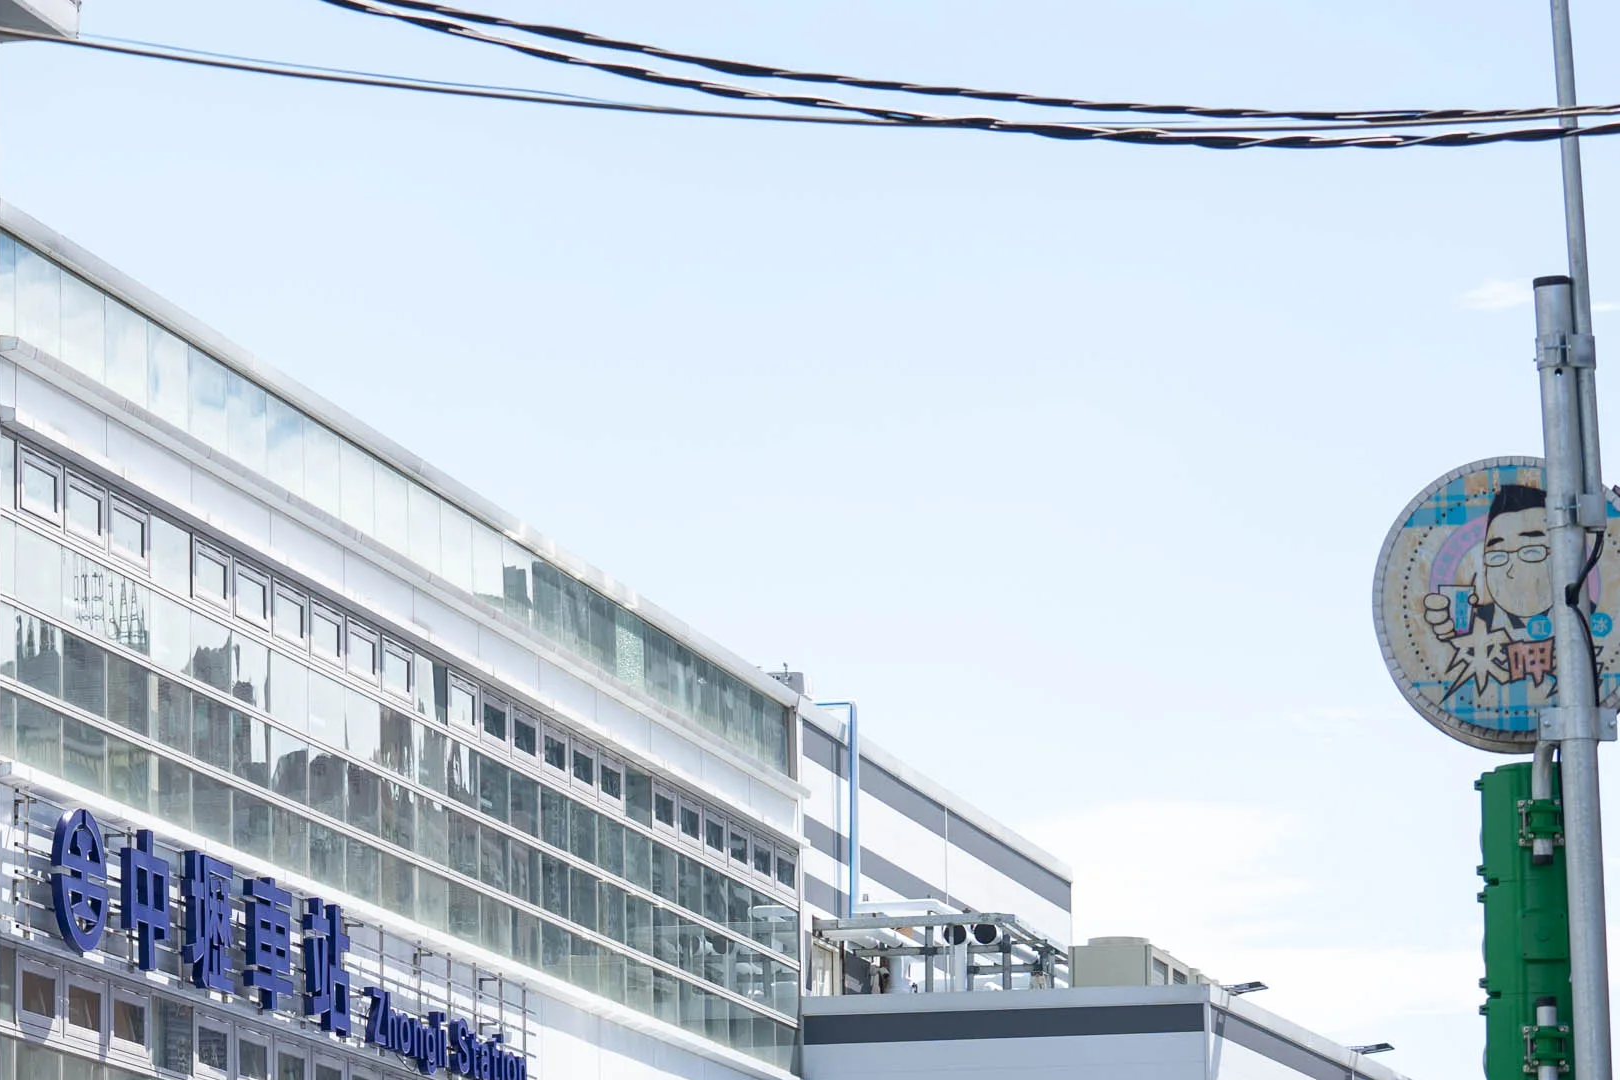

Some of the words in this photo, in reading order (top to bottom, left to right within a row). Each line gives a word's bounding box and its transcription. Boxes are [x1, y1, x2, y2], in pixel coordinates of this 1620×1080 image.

[120, 829, 351, 1038] 中壢車站
[364, 987, 446, 1075] Zhongli
